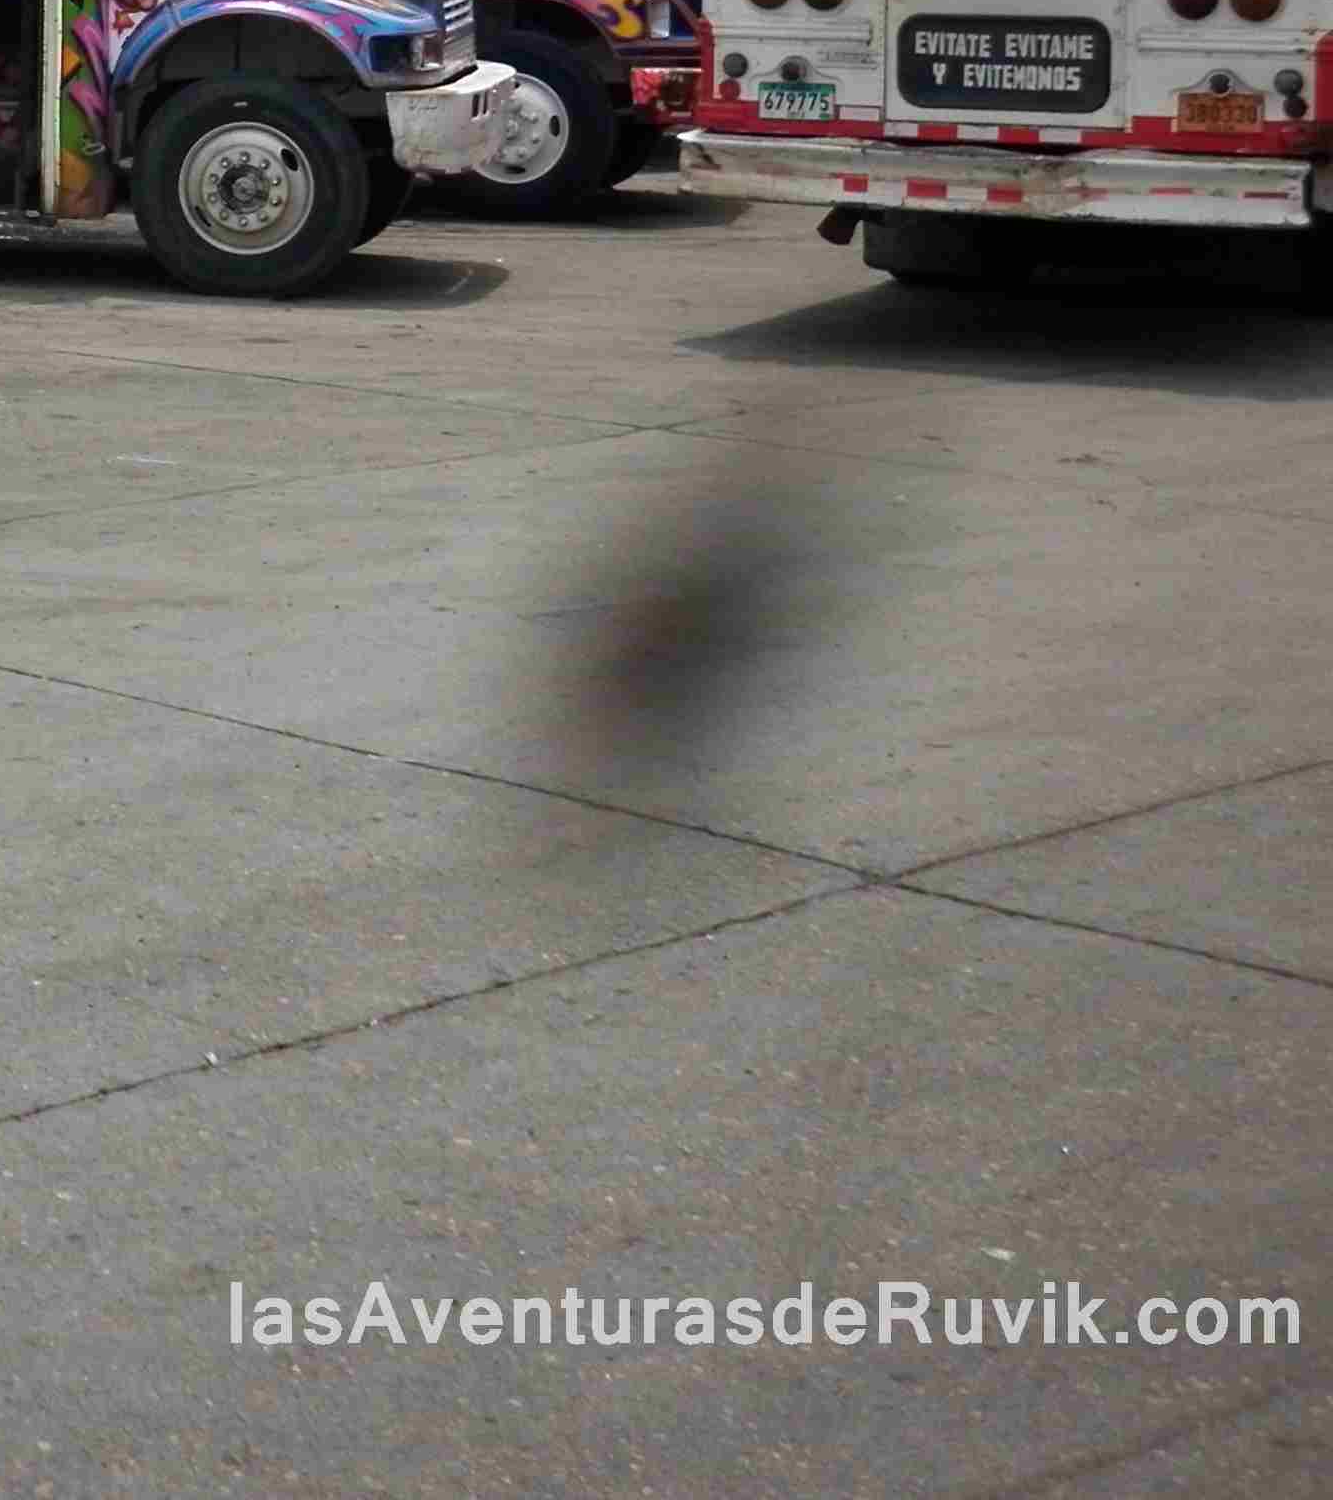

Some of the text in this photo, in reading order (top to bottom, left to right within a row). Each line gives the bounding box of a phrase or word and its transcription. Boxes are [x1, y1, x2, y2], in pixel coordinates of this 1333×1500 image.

[915, 31, 1094, 60] EVITATE EVITAME
[933, 63, 1081, 91] Y EVITEMONOS
[764, 91, 829, 111] 679775
